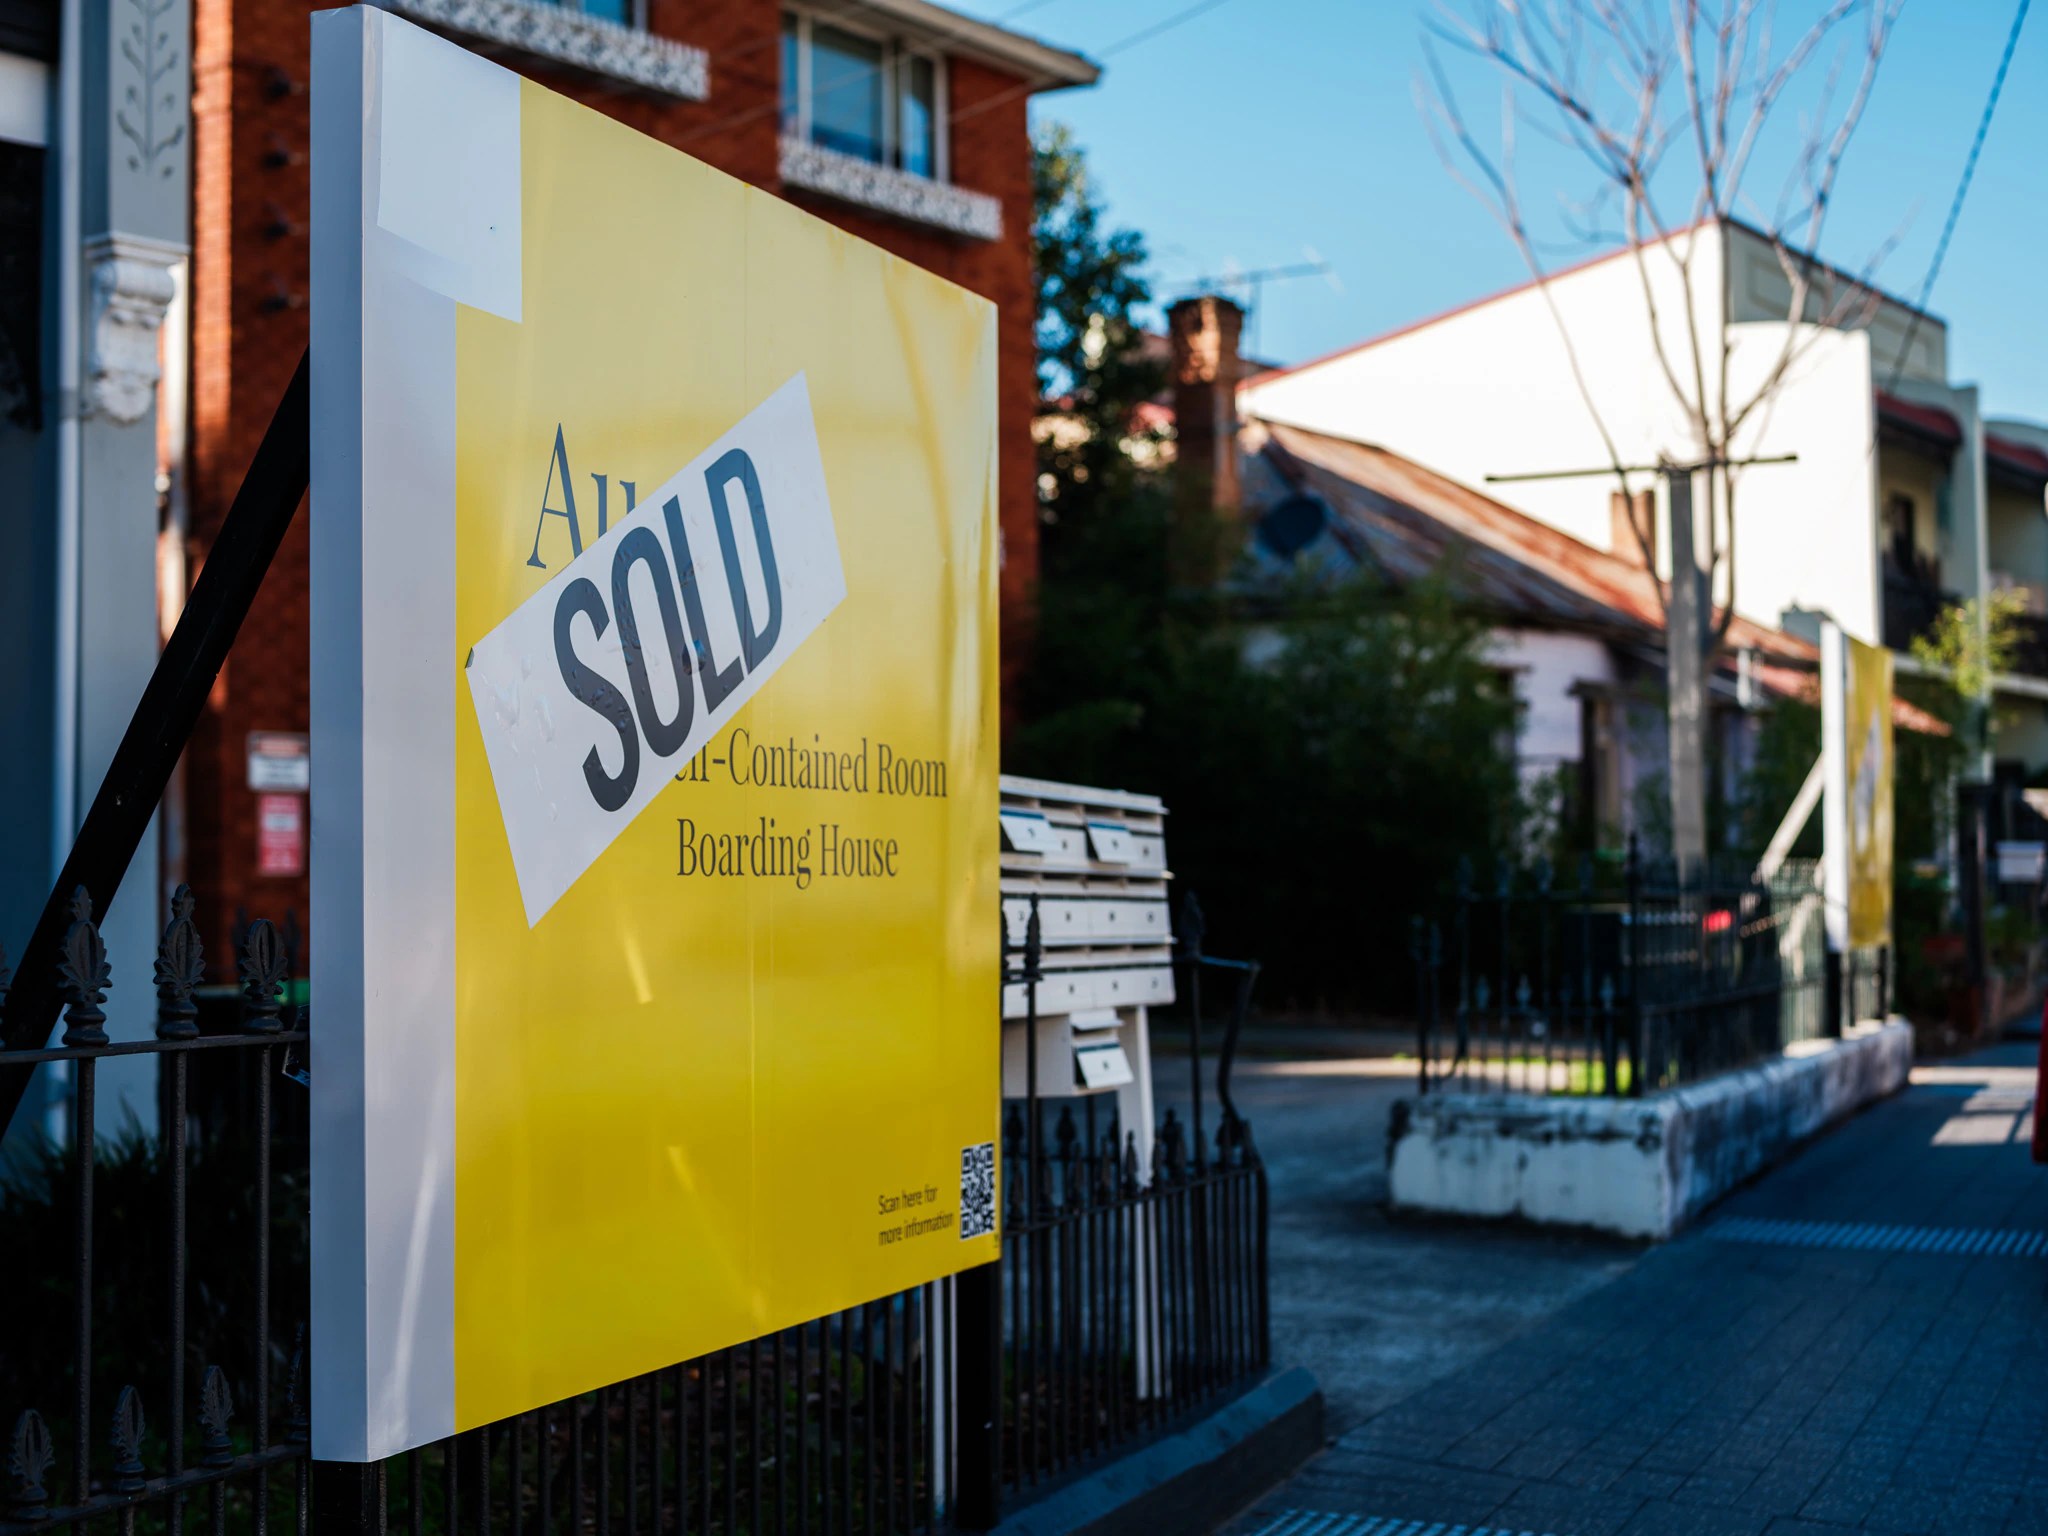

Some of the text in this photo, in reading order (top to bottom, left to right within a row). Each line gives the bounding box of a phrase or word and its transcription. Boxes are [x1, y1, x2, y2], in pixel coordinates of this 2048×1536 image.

[553, 447, 783, 812] SOLD
[876, 743, 948, 797] Room
[677, 816, 899, 890] Boarding House
[879, 1184, 938, 1215] Scan here for
[879, 1211, 954, 1246] more information
